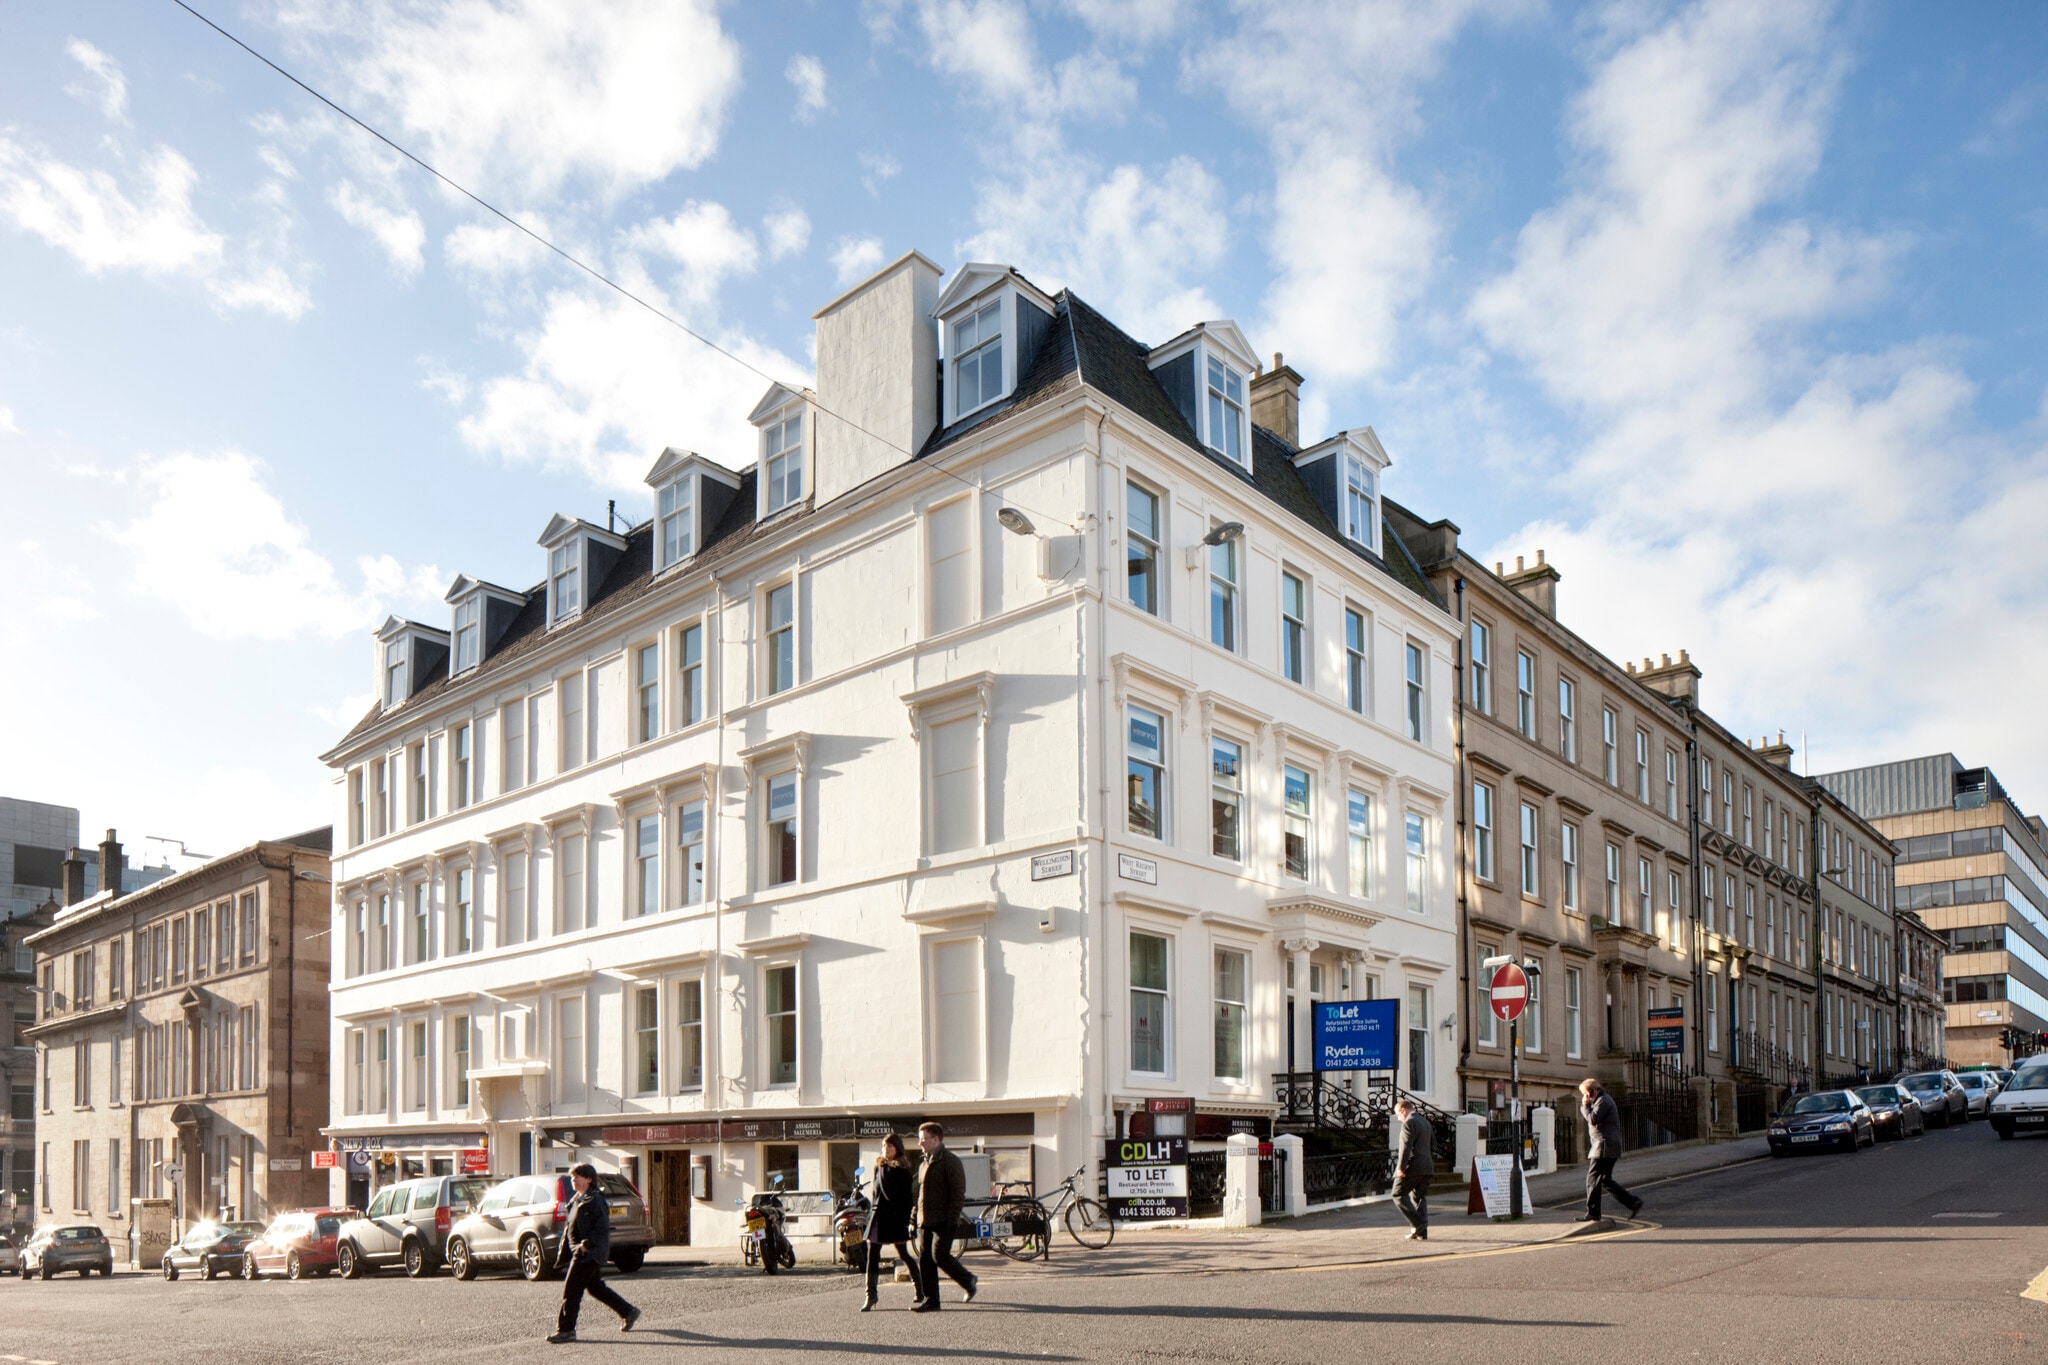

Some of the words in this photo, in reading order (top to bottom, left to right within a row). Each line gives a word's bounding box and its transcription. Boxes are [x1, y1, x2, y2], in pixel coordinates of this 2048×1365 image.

[1041, 864, 1062, 874] STREET
[1121, 856, 1134, 867] WEST
[1135, 860, 1154, 872] REGENT
[1129, 867, 1147, 877] STREET
[1325, 1059, 1342, 1067] 0141
[1360, 1058, 1381, 1066] 3838
[343, 1137, 364, 1150] NEWS
[365, 1136, 382, 1150] BOX
[1120, 1141, 1171, 1161] CDLH
[1125, 1169, 1140, 1181] TO
[1146, 1168, 1167, 1180] LET
[1128, 1197, 1167, 1206] cdlh.co.uk
[1119, 1207, 1138, 1217] 0141
[1140, 1207, 1154, 1216] 331
[1156, 1207, 1176, 1216] 0650
[980, 1224, 990, 1237] P
